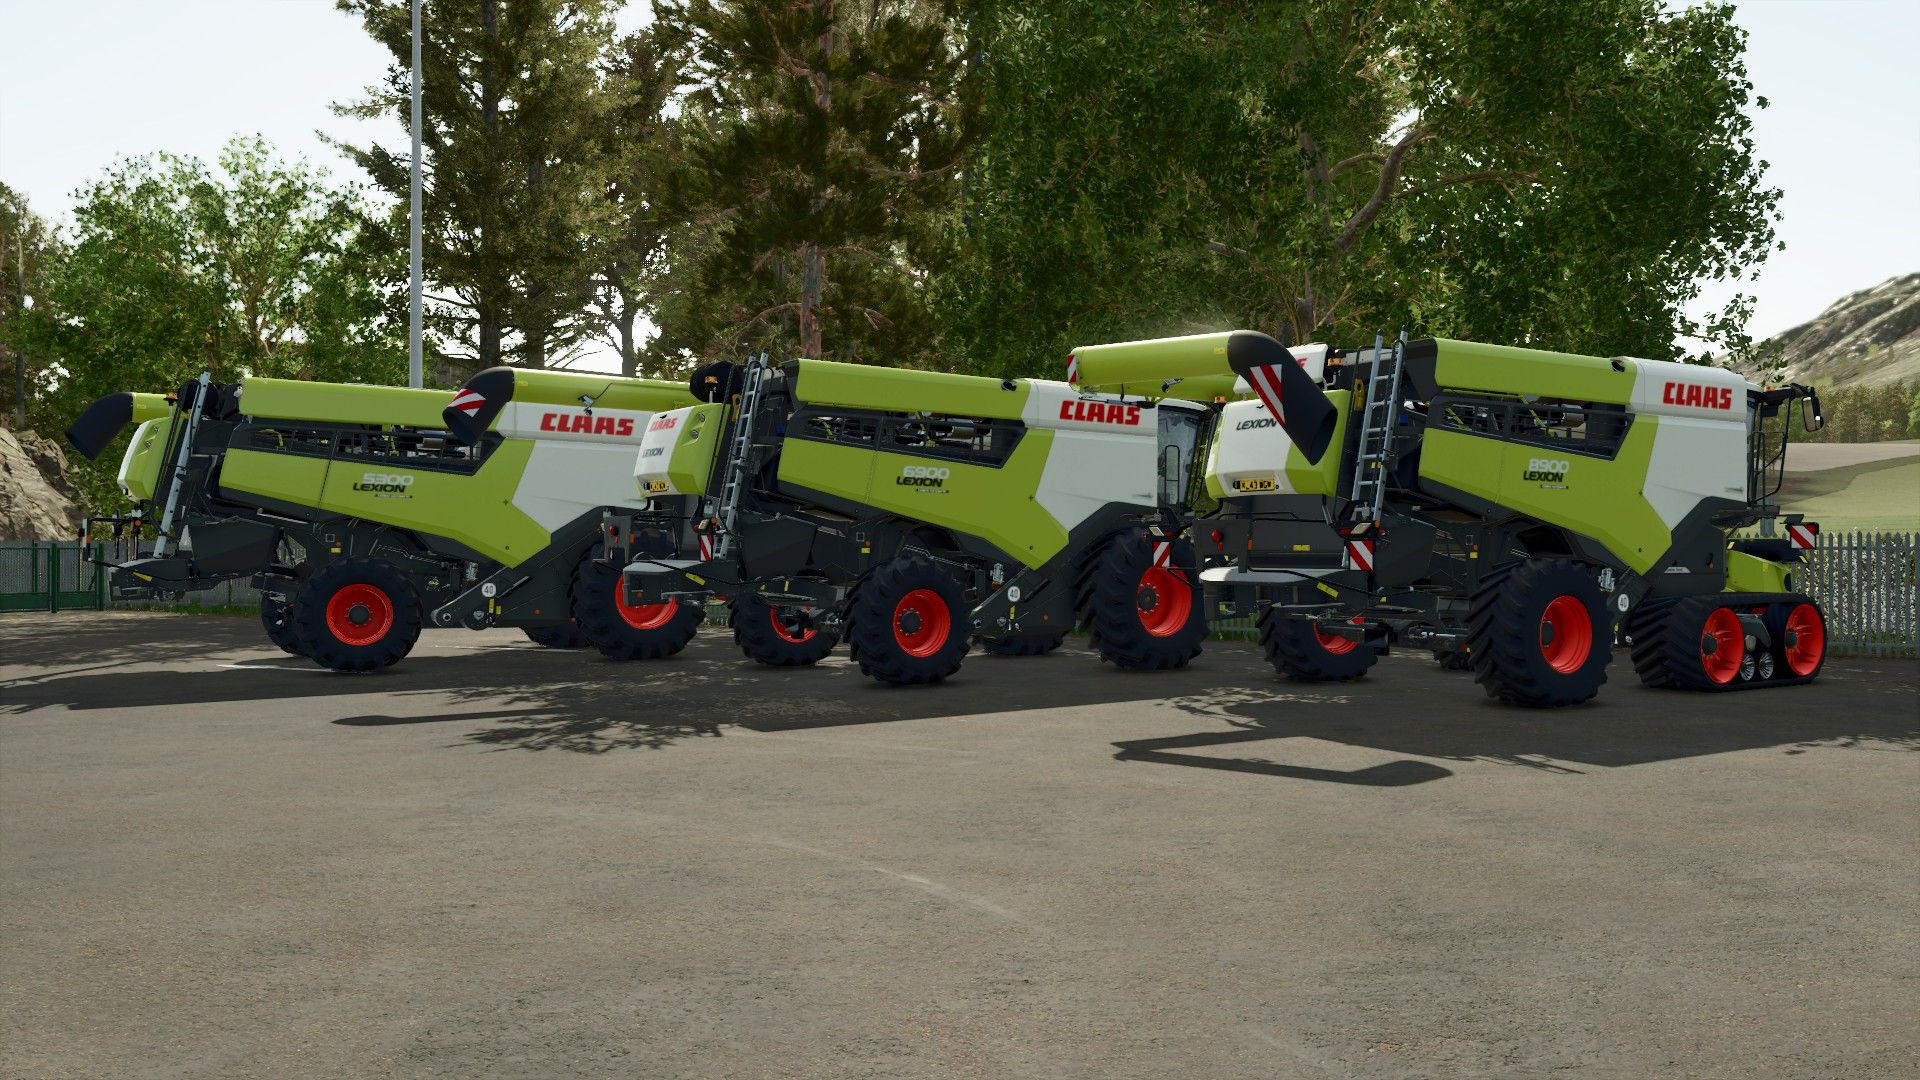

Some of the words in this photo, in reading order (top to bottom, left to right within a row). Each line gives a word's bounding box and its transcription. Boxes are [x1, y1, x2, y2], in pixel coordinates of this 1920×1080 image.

[1662, 381, 1733, 411] CLAAS
[1059, 399, 1140, 426] CLAAS
[540, 412, 634, 437] CLAAS
[649, 416, 678, 433] CLAAS
[1236, 417, 1277, 431] LEXION
[904, 465, 950, 480] 6900
[1529, 458, 1570, 474] 8900
[361, 472, 415, 486] 5300
[896, 475, 943, 488] LEXION
[1523, 470, 1564, 483] LEXION
[353, 482, 406, 493] LEXION
[484, 585, 494, 595] 40
[1009, 588, 1019, 599] 40
[1620, 596, 1628, 609] 40
